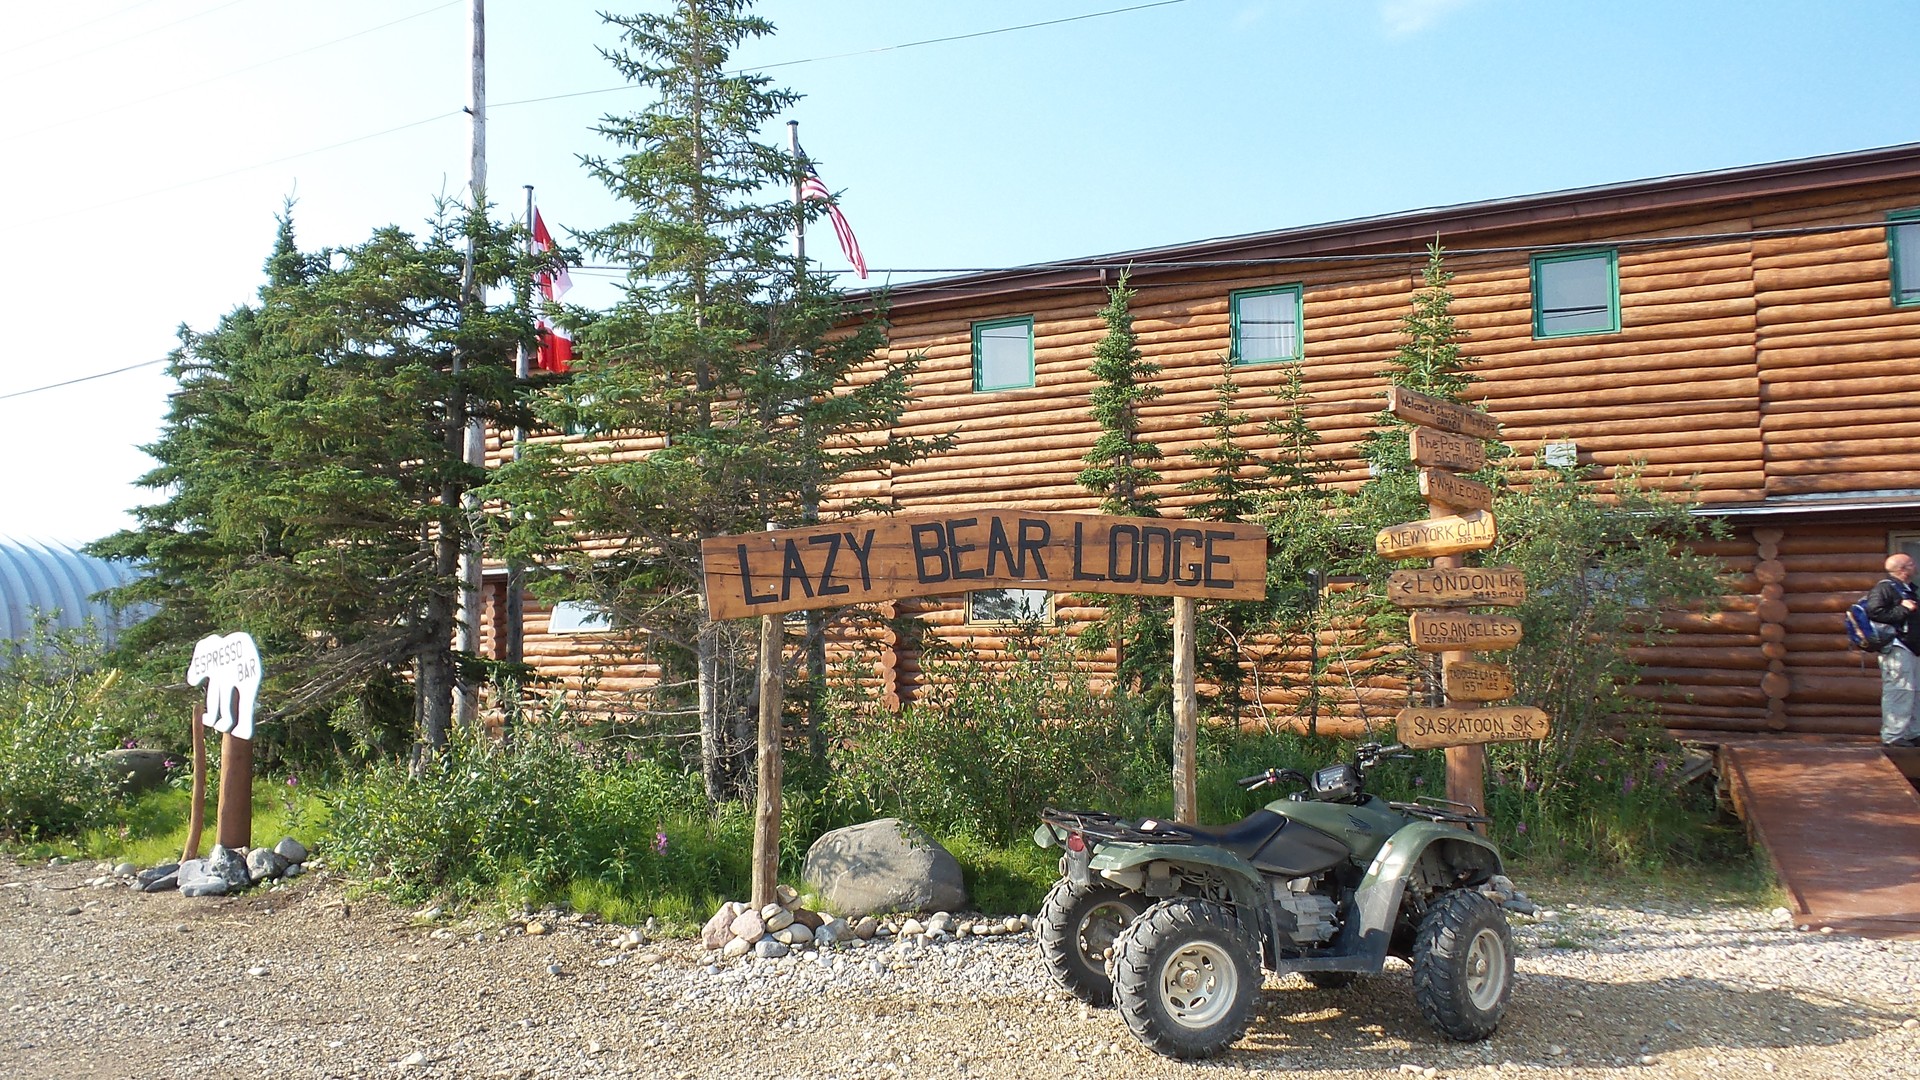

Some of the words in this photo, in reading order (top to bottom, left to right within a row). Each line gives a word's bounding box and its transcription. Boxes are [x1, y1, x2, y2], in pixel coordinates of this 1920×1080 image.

[1401, 396, 1430, 415] Welcome
[1418, 435, 1438, 449] The
[1440, 435, 1461, 452] Pas
[1465, 441, 1481, 458] MB
[1436, 476, 1464, 497] WHALE
[1465, 485, 1489, 503] COVE
[1390, 530, 1420, 549] NEW
[1420, 525, 1455, 543] YORK
[1457, 519, 1488, 537] CITY
[737, 528, 876, 606] LAZY
[911, 516, 1051, 584] BEAR
[1073, 520, 1236, 589] LODGE
[1417, 574, 1495, 594] LONDON
[1421, 621, 1448, 637] LOS
[1451, 622, 1508, 638] ANGELES
[194, 640, 243, 675] ESPRESSO
[237, 658, 257, 682] BAR
[1413, 715, 1504, 737] SASKATOON
[1490, 732, 1506, 740] 670
